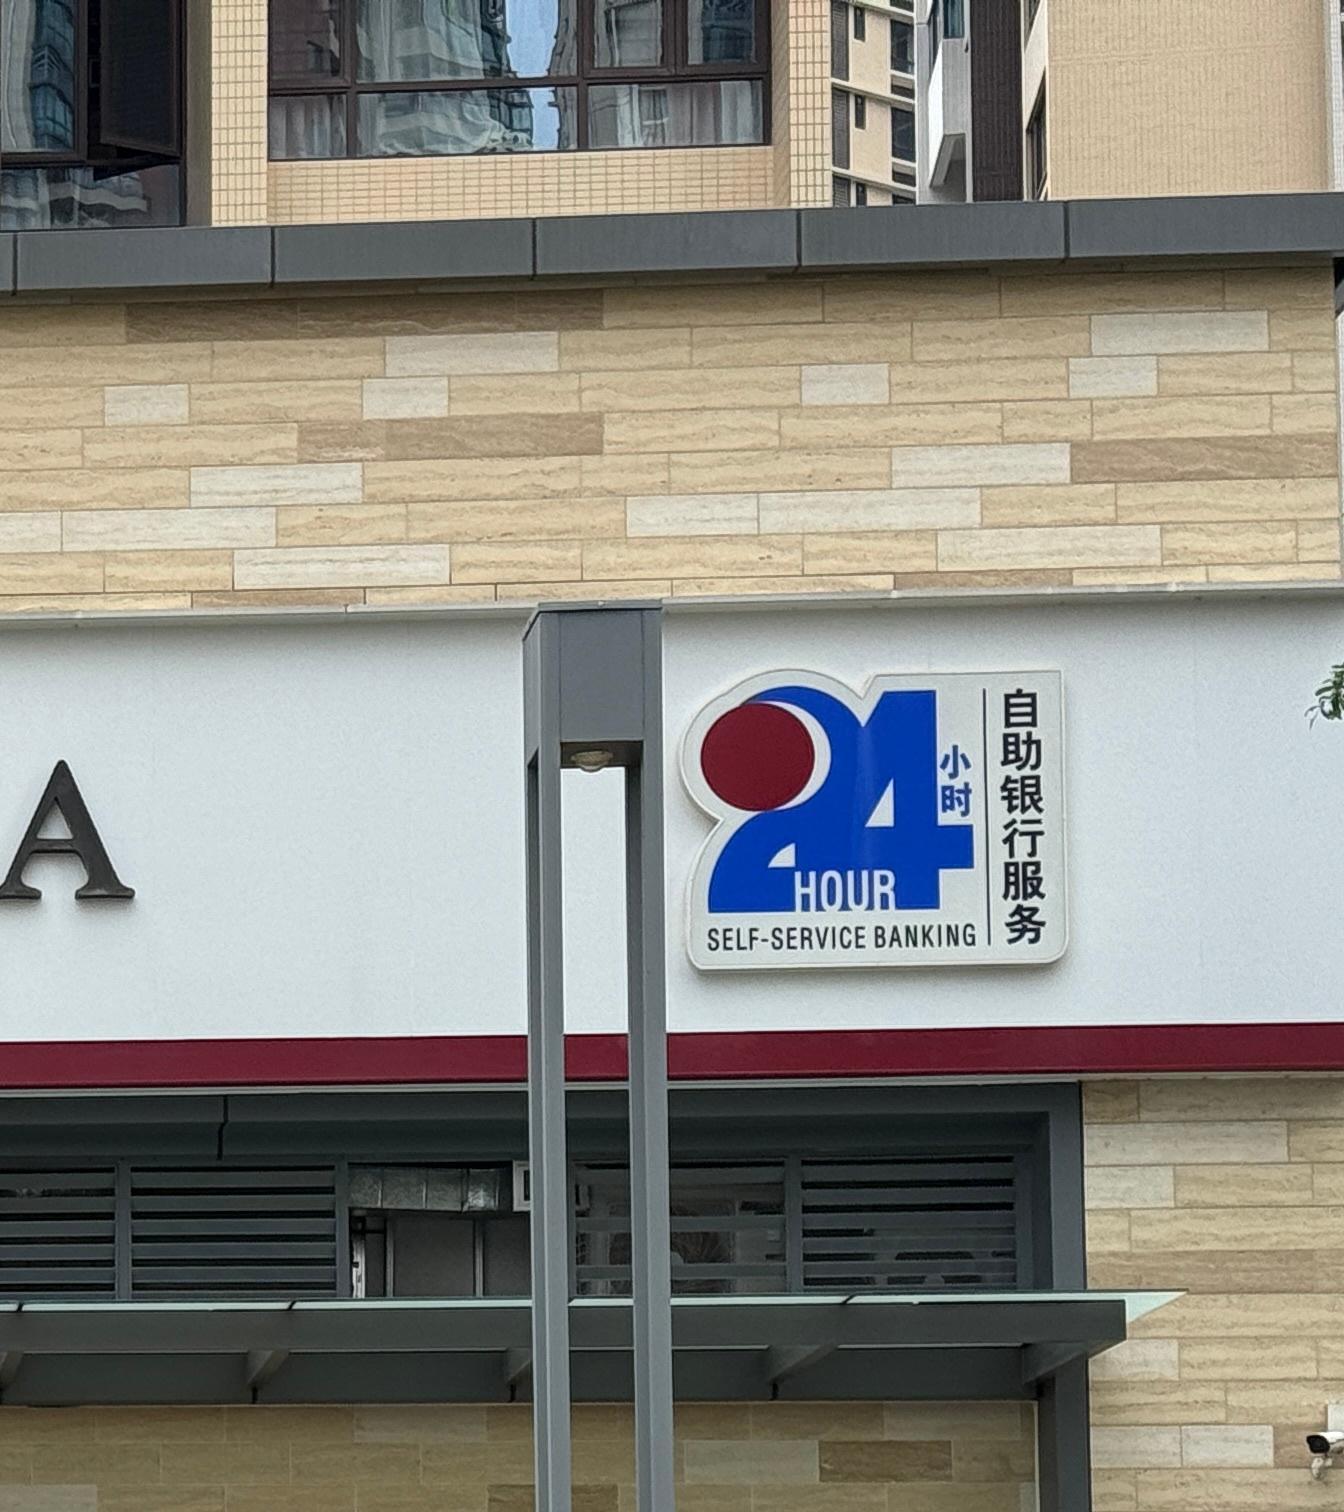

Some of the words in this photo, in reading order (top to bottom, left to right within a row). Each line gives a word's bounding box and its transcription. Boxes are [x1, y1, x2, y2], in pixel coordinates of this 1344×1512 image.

[700, 685, 974, 914] 24
[940, 745, 972, 817] 小时
[1000, 688, 1047, 945] 自助银行服务
[794, 869, 896, 912] HOUR
[707, 925, 867, 951] SELF-SERVICE
[874, 923, 977, 948] BANKING
